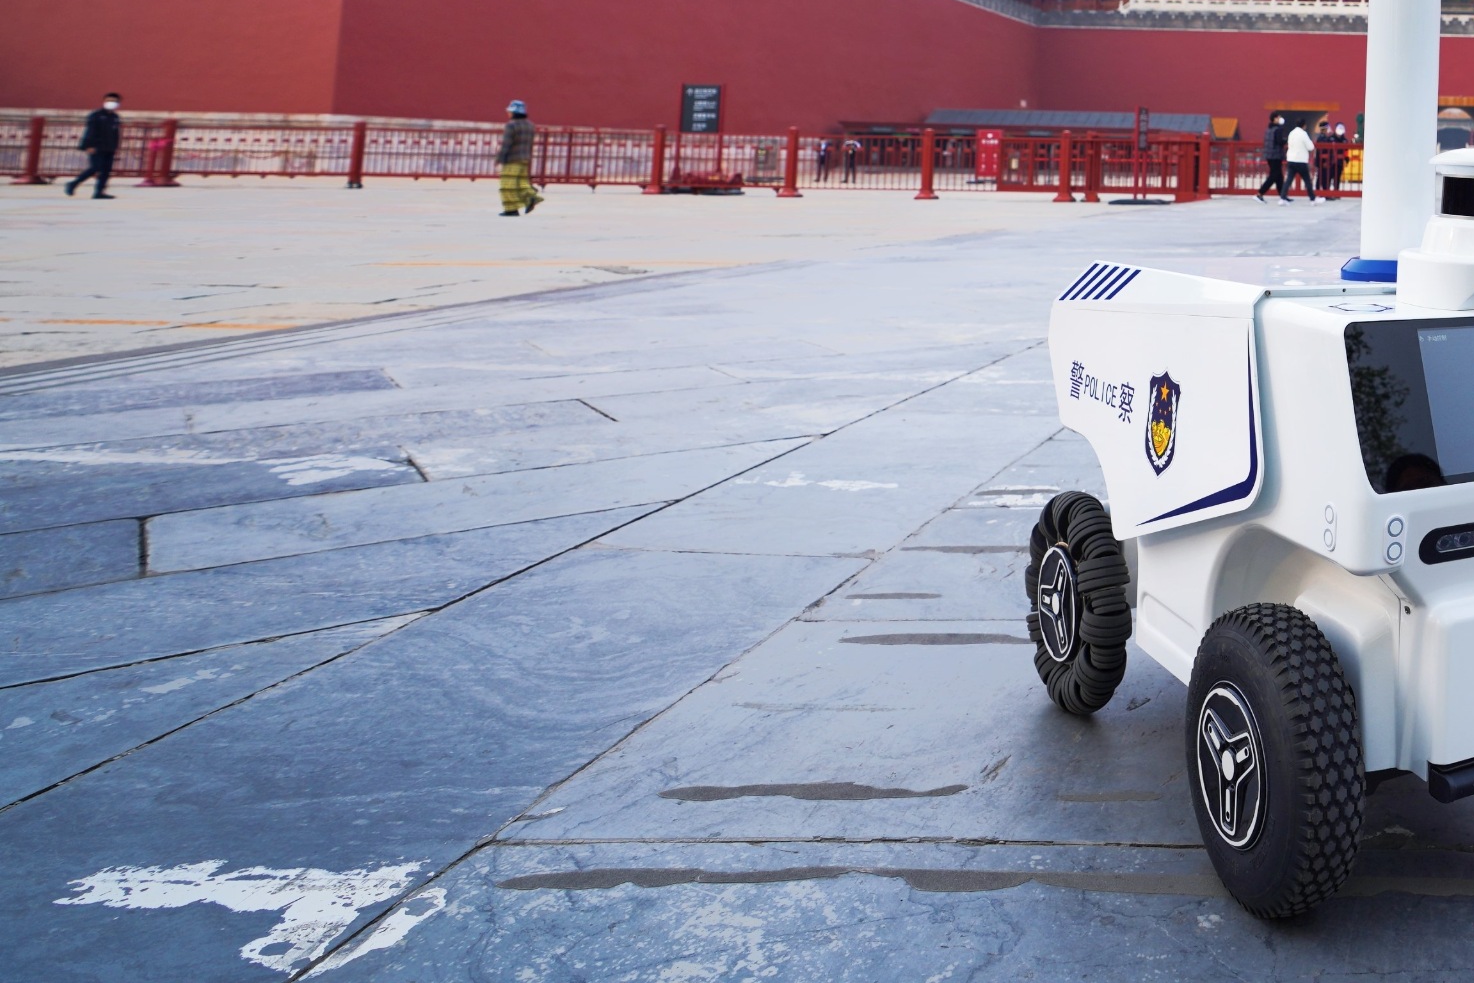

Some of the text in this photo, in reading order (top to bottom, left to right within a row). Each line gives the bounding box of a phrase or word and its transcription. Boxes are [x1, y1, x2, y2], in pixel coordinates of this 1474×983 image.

[1070, 360, 1134, 424] 警 POLICE 察
